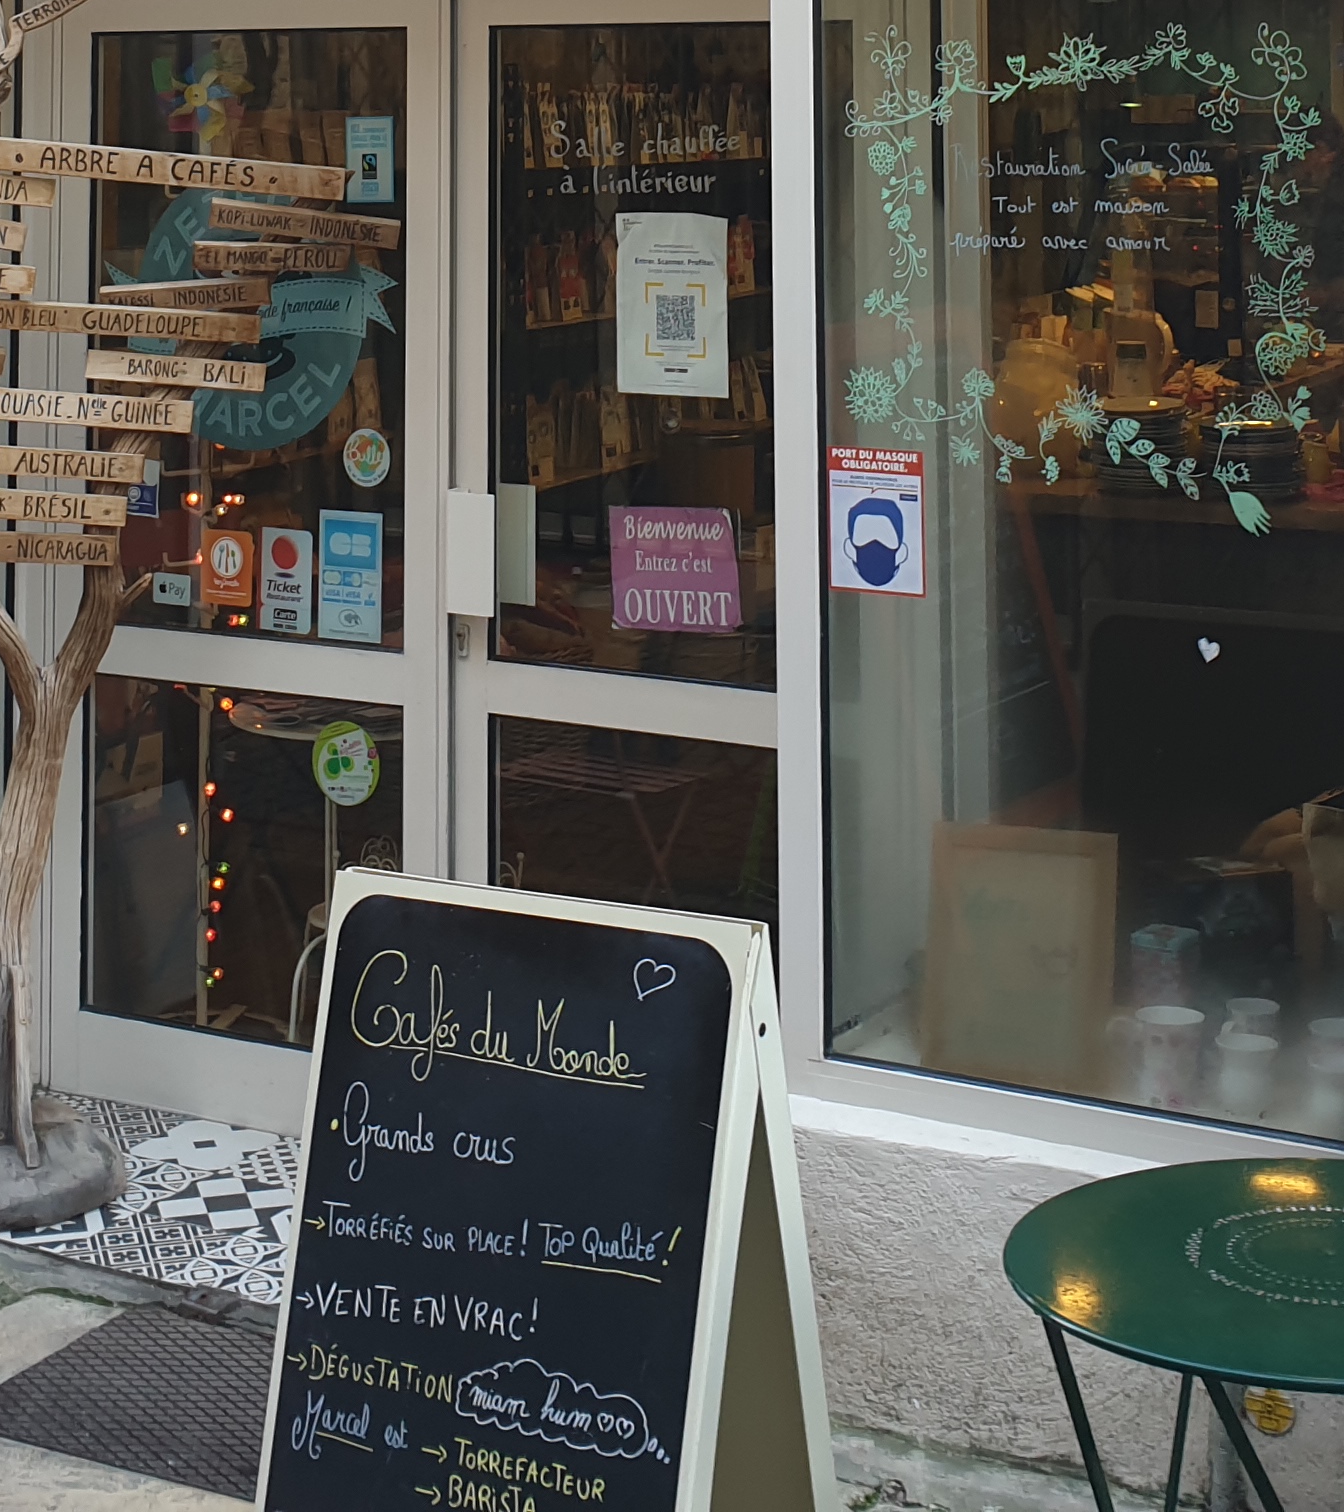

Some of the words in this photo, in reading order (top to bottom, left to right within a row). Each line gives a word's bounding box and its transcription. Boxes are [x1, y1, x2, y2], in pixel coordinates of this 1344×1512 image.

[550, 120, 624, 158] Salle
[643, 123, 741, 156] chauffée
[39, 147, 120, 174] ARBRE
[136, 155, 154, 177] A
[170, 161, 256, 187] CAFÉS
[559, 165, 576, 194] à
[592, 165, 716, 194] l'intérieur
[992, 196, 1036, 214] Tout
[1051, 197, 1077, 214] est
[1095, 198, 1169, 216] maison
[949, 226, 1025, 255] préparé
[1042, 234, 1089, 250] avec
[1106, 235, 1170, 251] amour
[81, 310, 204, 337] GUADELOUPE
[13, 452, 117, 478] AUSTRALIE
[832, 448, 857, 457] PORT
[859, 450, 873, 459] DU
[876, 452, 918, 462] MASQUE
[842, 459, 907, 472] OBLIGATOIRE.
[22, 494, 92, 520] BRÉSIL
[624, 515, 724, 541] Bienvenue
[17, 541, 108, 562] NICARAGUA
[635, 550, 677, 572] Entrez
[682, 551, 713, 574] c'est
[169, 582, 185, 599] Pay
[266, 579, 302, 594] Ticket
[624, 588, 732, 626] OUVERT
[351, 948, 460, 1081] Cafés
[469, 990, 515, 1064] du
[528, 998, 647, 1079] Monde
[342, 1081, 435, 1181] Grands
[453, 1129, 516, 1165] crus
[422, 1222, 456, 1253] SUR
[315, 1282, 401, 1324] VENTE
[414, 1296, 446, 1327] EN
[309, 1344, 453, 1402] DÉGUSTATION
[468, 1385, 530, 1421] miam
[541, 1378, 591, 1433] hum
[290, 1388, 371, 1461] Marcel
[384, 1423, 409, 1450] est
[454, 1435, 606, 1502] TORREFACTEUR
